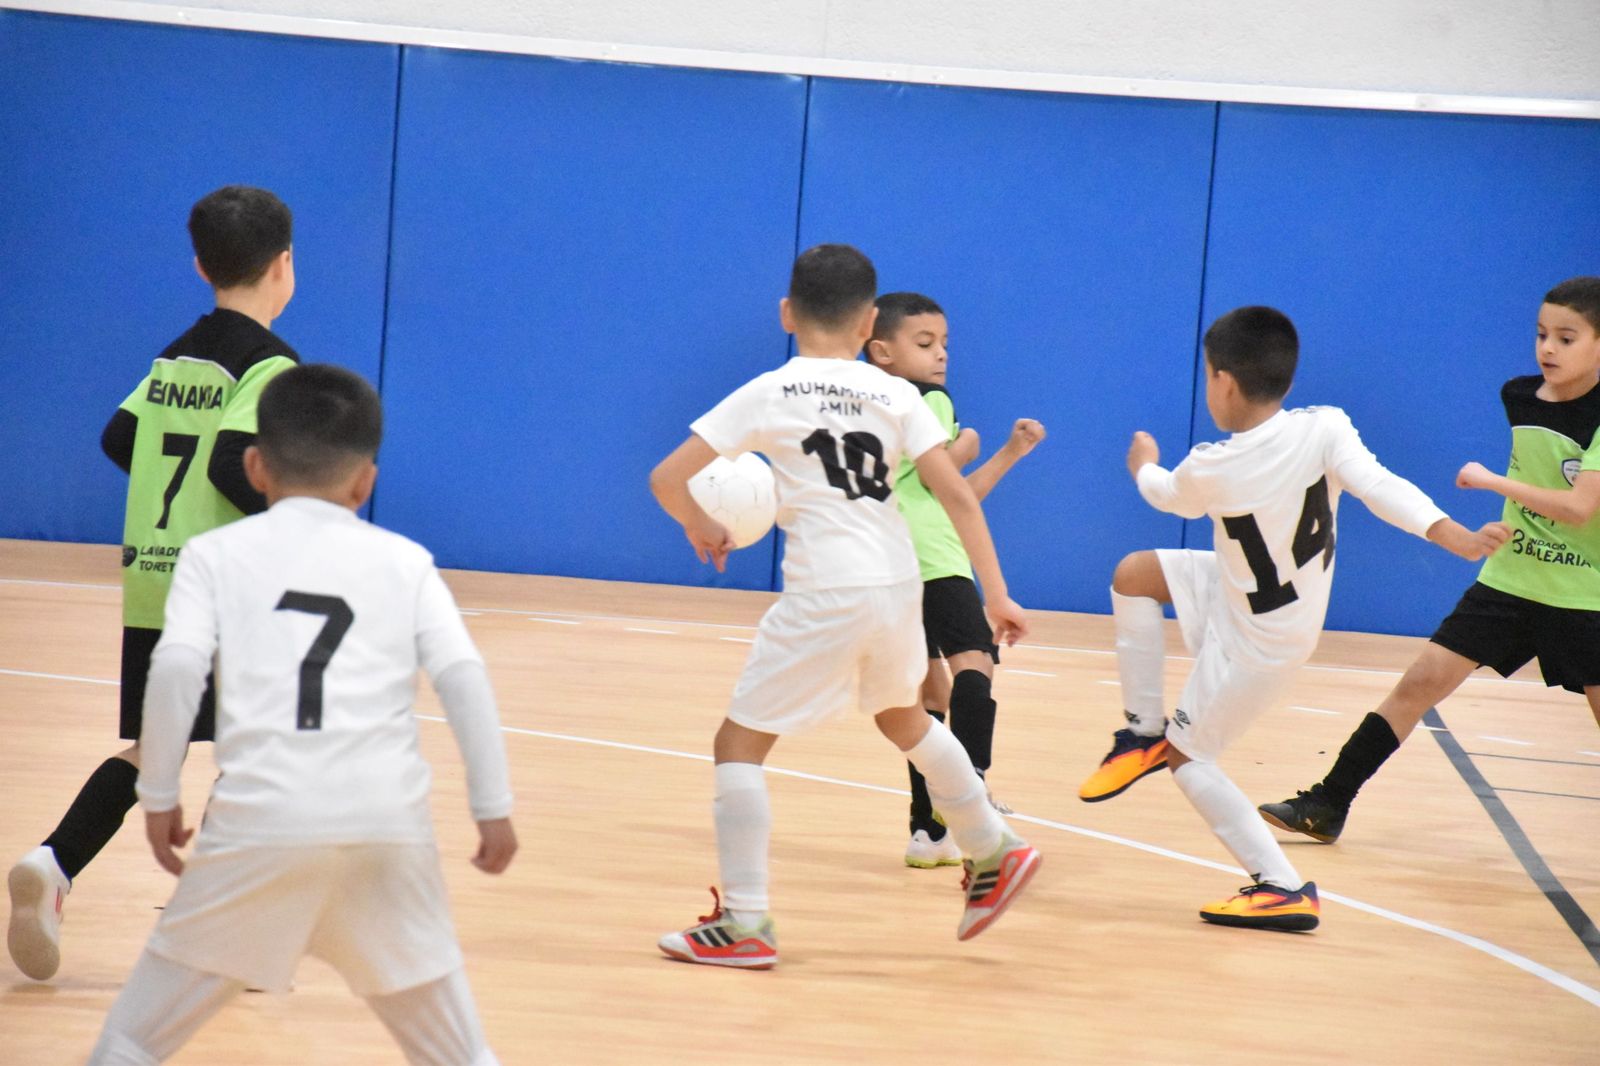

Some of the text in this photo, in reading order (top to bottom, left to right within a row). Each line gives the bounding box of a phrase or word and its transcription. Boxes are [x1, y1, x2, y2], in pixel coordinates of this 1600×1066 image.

[819, 400, 863, 416] AMIN
[155, 433, 200, 530] 7
[801, 428, 892, 503] 10
[1222, 474, 1335, 615] 14
[274, 590, 355, 731] 7
